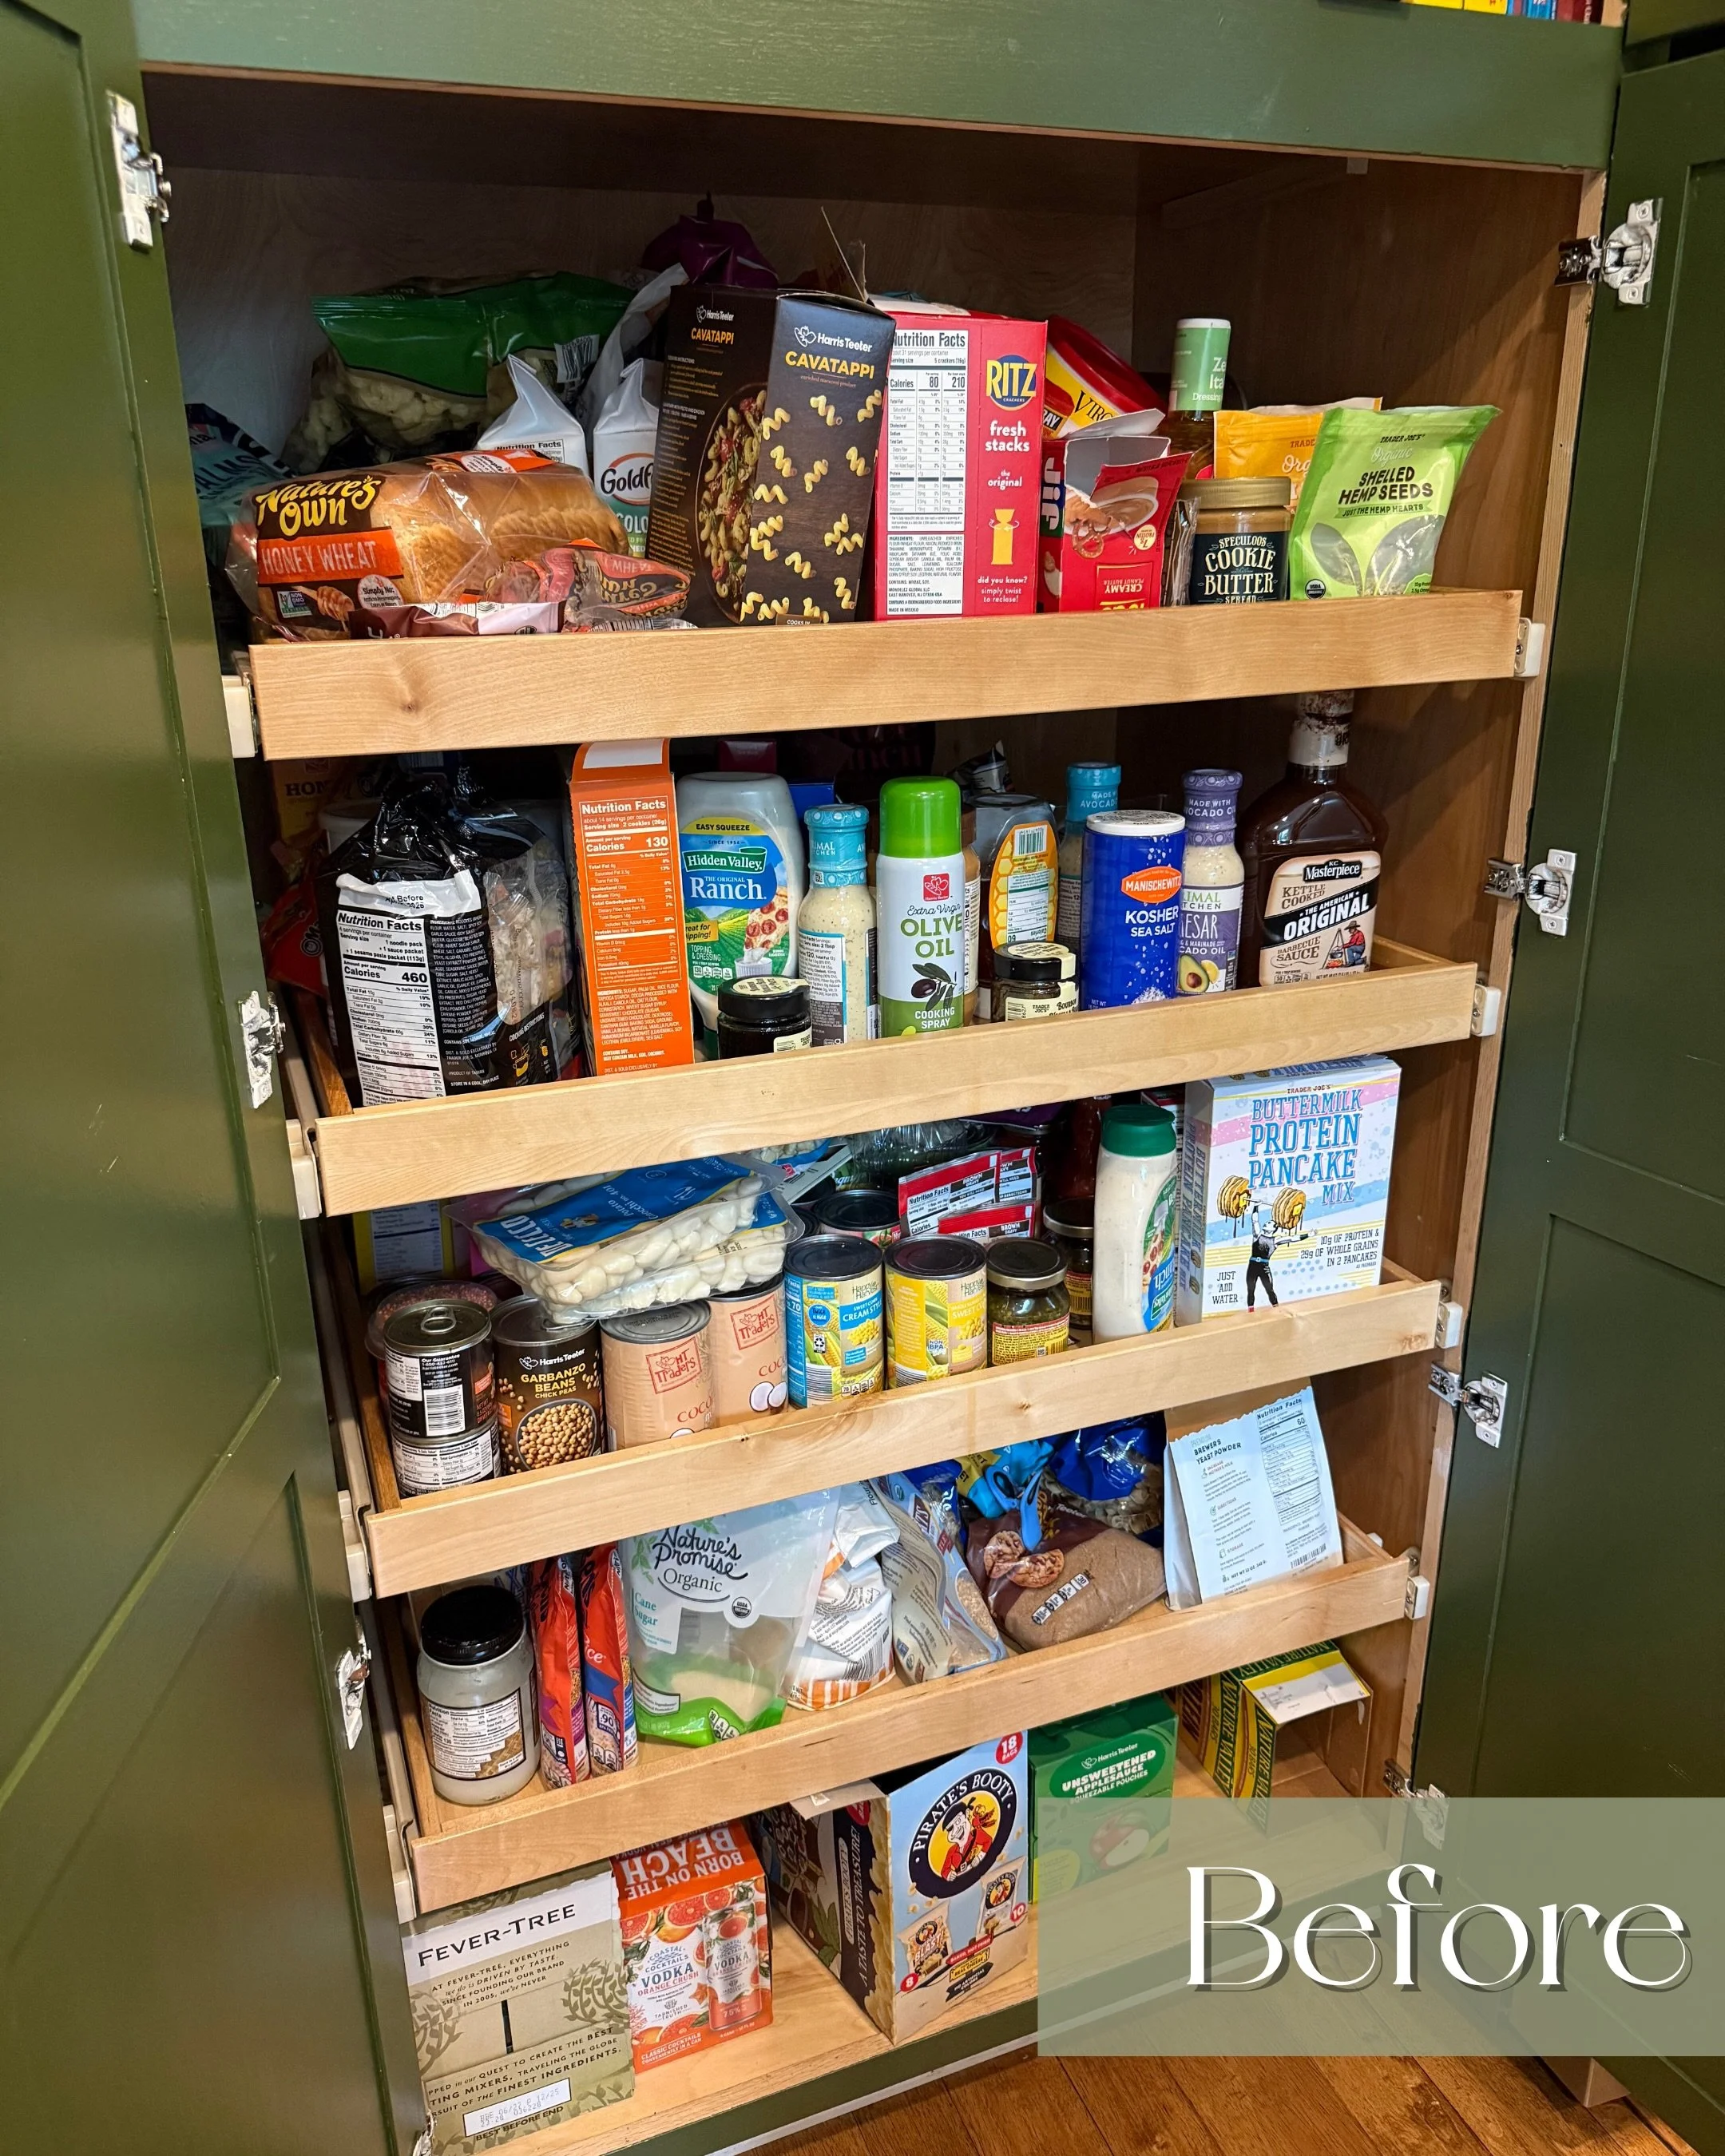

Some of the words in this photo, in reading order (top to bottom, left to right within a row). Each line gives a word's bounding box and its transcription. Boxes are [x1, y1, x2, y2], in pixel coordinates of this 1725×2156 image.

[692, 327, 735, 345] CAVATAPPI
[818, 334, 845, 349] Harris
[845, 338, 873, 353] Teeter
[939, 332, 966, 347] Facts
[785, 351, 875, 379] CAVATAPPI
[890, 379, 914, 388] Calories
[930, 376, 939, 388] 80
[952, 376, 966, 388] 210
[986, 359, 1037, 399] RITZ
[990, 421, 1026, 437] fresh
[985, 437, 1029, 452] stacks
[1370, 446, 1413, 467] Organic
[601, 462, 653, 495] Goldf
[988, 477, 1022, 491] original
[1358, 466, 1415, 487] SHELLED
[255, 474, 382, 526] Nature's
[1338, 487, 1378, 505] HEMP
[1378, 482, 1434, 501] SEEDS
[1342, 508, 1357, 517] JUST
[1357, 506, 1369, 515] THE
[1392, 503, 1424, 513] HEARTS
[1219, 535, 1267, 549] SPECULOOS
[261, 545, 316, 576] HONEY
[319, 540, 377, 573] WHEAT
[1204, 546, 1276, 573] COOKIE
[1104, 583, 1143, 594] CREAMY
[1204, 573, 1275, 596] BUTTER
[1224, 595, 1256, 604] SPREAD
[581, 803, 632, 814] Nutrition
[635, 799, 666, 811] Facts
[1188, 799, 1205, 807] MADE
[1210, 799, 1231, 807] WITH
[586, 842, 625, 853] Calories
[645, 836, 668, 848] 130
[687, 854, 727, 866] Hidden
[1304, 863, 1361, 880] Masterpiece
[689, 877, 765, 900] Ranch
[1125, 875, 1182, 892] MANISCHEWITZ
[1281, 883, 1326, 898] KETTLE
[907, 905, 935, 917] Extra
[935, 903, 962, 915] Virgin
[1281, 890, 1326, 910] COOKED
[1305, 905, 1318, 915] THE
[1319, 891, 1354, 910] AMERICAN
[337, 912, 383, 929] Nutrition
[387, 918, 422, 932] Facts
[900, 914, 963, 937] OLIVE
[1125, 906, 1180, 925] KOSHER
[1283, 893, 1370, 941] ORIGINAL
[1130, 926, 1152, 938] SEA
[1154, 922, 1176, 936] SALT
[915, 940, 955, 958] OIL
[1189, 939, 1216, 948] MARINADE
[1211, 945, 1226, 954] OIL
[1277, 935, 1322, 954] BARBECUE
[1276, 945, 1319, 963] SAUCE
[344, 967, 381, 980] Calories
[401, 972, 428, 984] 460
[914, 1006, 955, 1020] COOKING
[921, 1017, 950, 1030] SPRAY
[1251, 1088, 1364, 1122] BUTTERMILK
[1248, 1113, 1362, 1157] PROTEIN
[1247, 1148, 1358, 1191] PANCAKE
[909, 1191, 934, 1206] Nutrition
[933, 1185, 950, 1198] Facts
[1321, 1181, 1354, 1207] MIX
[608, 1199, 635, 1218] Potato
[910, 1223, 931, 1235] Calories
[1001, 1222, 1021, 1231] BROWN
[1300, 1250, 1314, 1260] 29g
[1314, 1247, 1324, 1258] OF
[1326, 1245, 1351, 1255] WHOLE
[1352, 1240, 1378, 1252] GRAINS
[1216, 1271, 1236, 1282] JUST
[1219, 1282, 1233, 1293] ADD
[1211, 1293, 1239, 1305] WATER
[757, 1305, 771, 1322] HT
[738, 1314, 775, 1341] Traders
[433, 1353, 461, 1362] Guarantee
[539, 1355, 564, 1367] Harris
[563, 1348, 585, 1362] Teeter
[676, 1347, 690, 1366] HT
[521, 1362, 586, 1384] GARBANZO
[654, 1357, 696, 1384] Traders
[534, 1377, 576, 1393] BEANS
[534, 1391, 558, 1400] CHICK
[558, 1386, 577, 1397] PEAS
[1256, 1404, 1283, 1421] Nutrition
[1285, 1397, 1303, 1409] Facts
[1196, 1452, 1214, 1465] YEAST
[1214, 1441, 1242, 1459] POWDER
[660, 1524, 742, 1560] Nature's
[652, 1543, 749, 1580] Promise
[663, 1567, 723, 1593] Organic
[635, 1592, 657, 1612] Cane
[633, 1609, 658, 1627] Sugar
[1001, 1734, 1017, 1755] 18
[1097, 1747, 1119, 1762] Harris
[1118, 1742, 1139, 1756] Teeter
[1061, 1749, 1156, 1793] UNSWEETENED
[1075, 1762, 1144, 1796] APPLESAUCE
[1069, 1780, 1116, 1805] SQUEEZABLE
[1116, 1769, 1148, 1789] POUCHES
[912, 1778, 969, 1851] PIRATE'S
[971, 1770, 1015, 1802] BOOTY
[619, 1826, 739, 1886] BEACH
[694, 1851, 745, 1877] BORN
[664, 1867, 691, 1888] ON
[625, 1878, 663, 1901] THE
[418, 1903, 576, 1967] FEVER-TREE
[649, 1945, 683, 1961] COASTAL
[914, 1932, 945, 1966] BLAST!
[447, 1964, 506, 1988] FEVER-TREE,
[510, 1940, 570, 1966] EVERYTHING
[644, 1954, 689, 1973] COCKTAILS
[714, 1951, 750, 1972] VODKA
[441, 1994, 467, 2007] SINCE
[469, 1979, 514, 1996] FOUNDING
[516, 1972, 535, 1982] OUR
[536, 1960, 565, 1976] BRAND
[637, 1981, 672, 1996] ORANGE
[672, 1970, 700, 1985] CRUSH
[640, 1962, 694, 1988] VODKA
[464, 2076, 478, 2085] our
[478, 2063, 510, 2079] QUEST
[514, 2060, 526, 2069] TO
[529, 2047, 564, 2063] CREATE
[565, 2037, 585, 2049] THE
[587, 2026, 614, 2042] BEST
[465, 2075, 514, 2096] MIXERS,
[518, 2057, 568, 2077] TRAVELING
[569, 2048, 588, 2059] THE
[589, 2037, 618, 2051] GLOBE
[461, 2099, 474, 2108] OF
[477, 2092, 494, 2102] THE
[497, 2075, 537, 2096] FINEST
[541, 2047, 622, 2081] INGREDIENTS.
[475, 2128, 501, 2142] BEST
[502, 2115, 542, 2133] BEFORE
[542, 2106, 564, 2118] END
